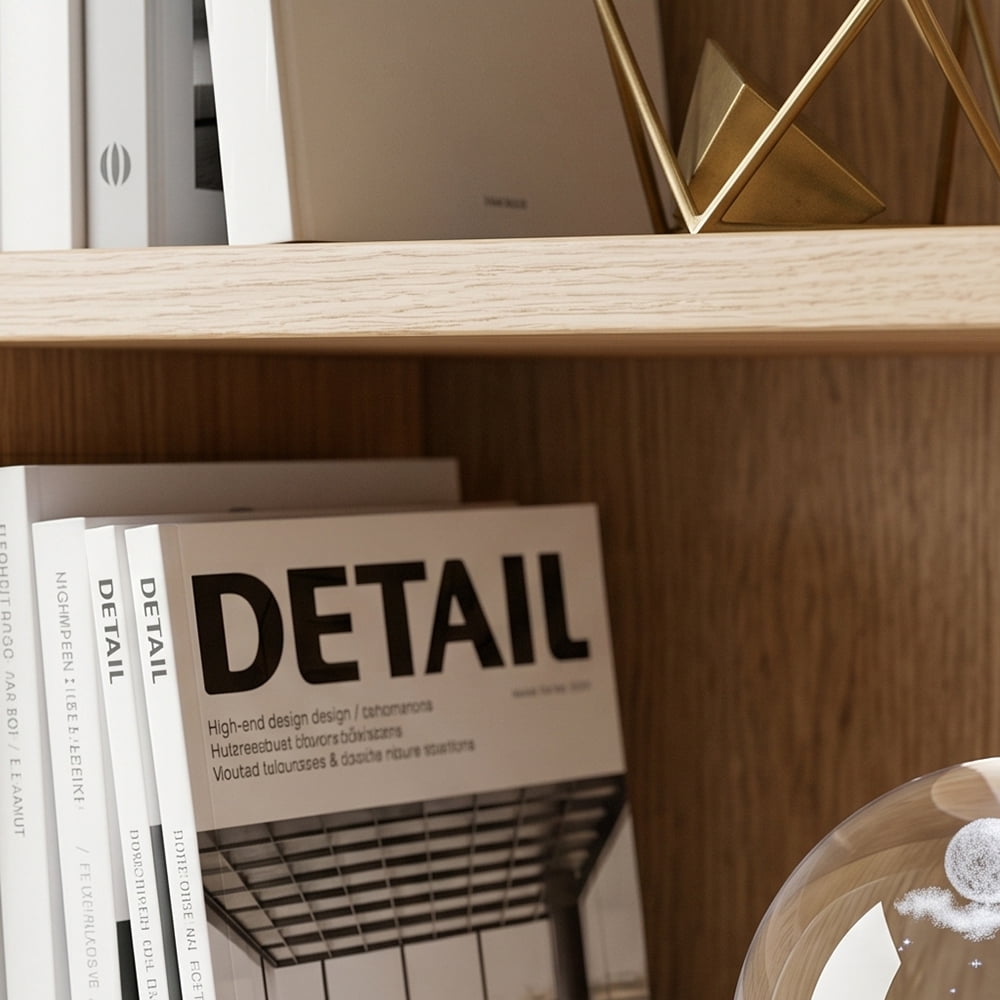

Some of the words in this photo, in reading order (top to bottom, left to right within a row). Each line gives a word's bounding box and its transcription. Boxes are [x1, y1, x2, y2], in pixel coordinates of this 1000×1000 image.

[99, 579, 125, 684] DETAIL
[140, 577, 168, 684] DETAIL
[191, 552, 590, 695] DETAIL
[207, 714, 265, 739] High-end
[268, 711, 309, 732] design
[311, 706, 351, 726] design
